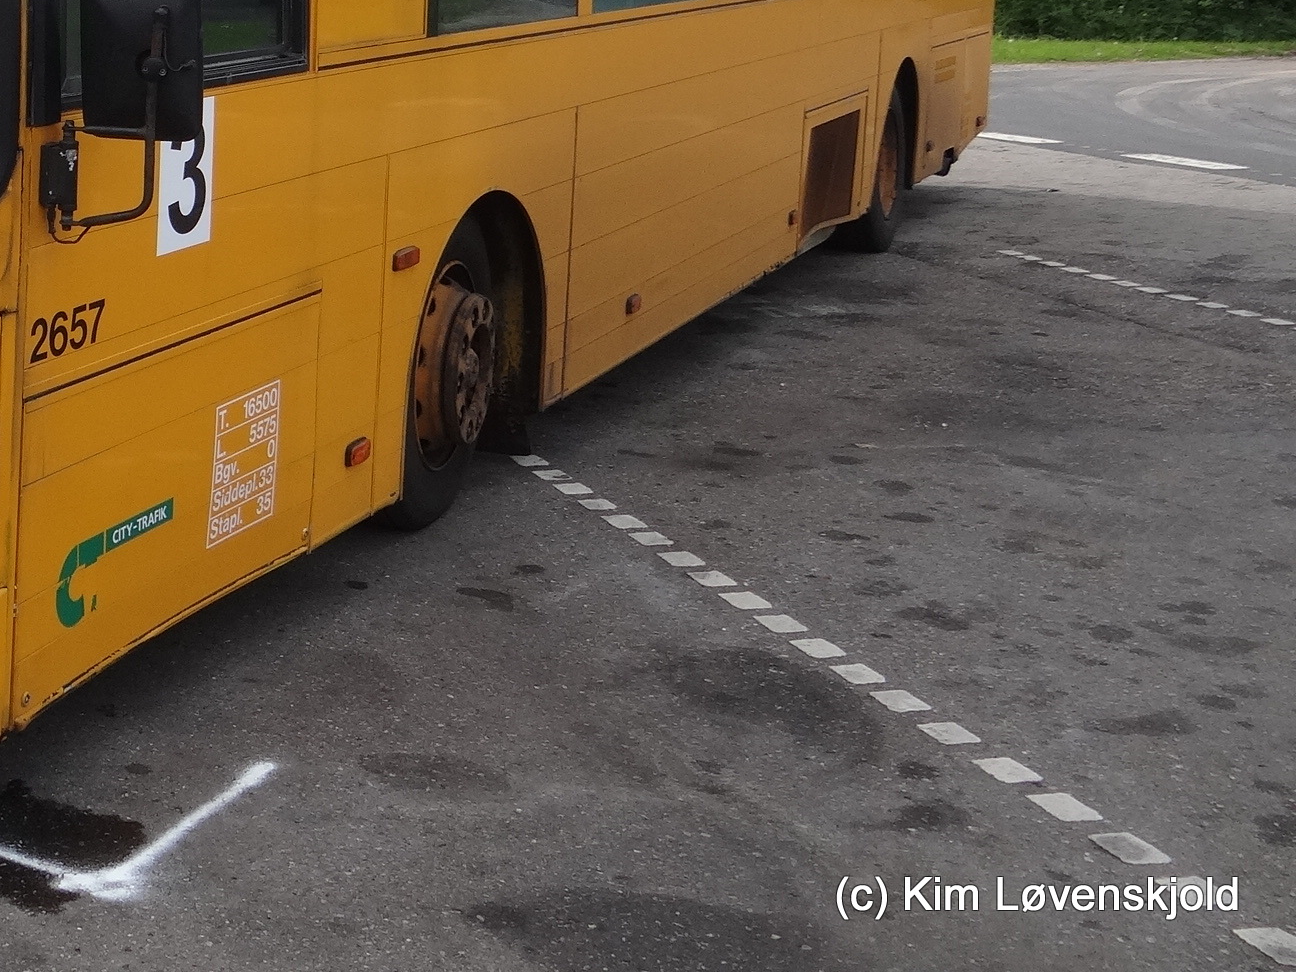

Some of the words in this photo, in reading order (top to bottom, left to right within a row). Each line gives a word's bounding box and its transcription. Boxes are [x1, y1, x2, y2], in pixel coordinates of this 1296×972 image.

[168, 125, 207, 235] 3
[30, 297, 106, 364] 2657
[218, 410, 230, 429] T.
[243, 388, 278, 419] 16500
[216, 440, 227, 459] L.
[248, 414, 277, 444] 5575
[214, 461, 240, 485] Bgv.
[267, 439, 275, 458] 0
[258, 465, 274, 489] 33
[112, 505, 167, 543] CITY-TRAFIK
[209, 507, 243, 539] Stapl.
[256, 492, 272, 515] 35
